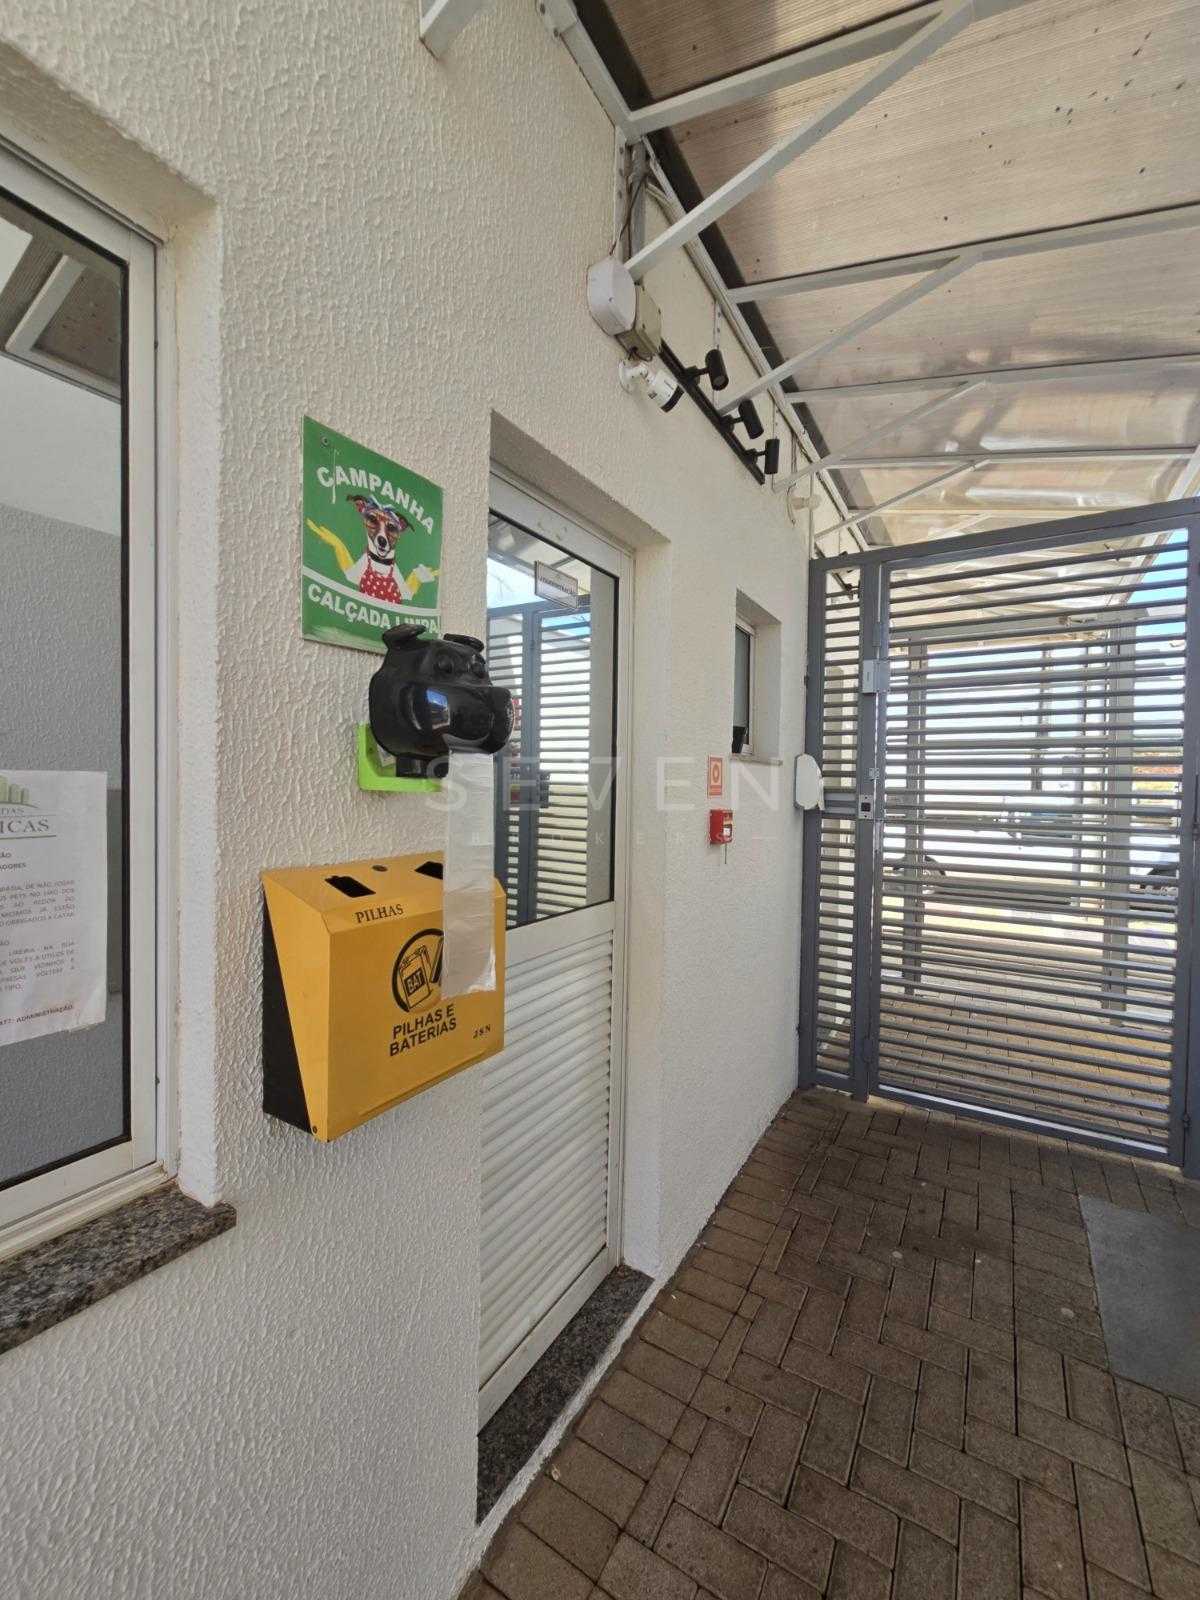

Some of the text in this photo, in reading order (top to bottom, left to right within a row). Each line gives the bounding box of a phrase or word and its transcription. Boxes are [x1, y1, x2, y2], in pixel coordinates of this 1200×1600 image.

[316, 464, 434, 536] CAMPANHA
[307, 583, 392, 629] CALÇADA
[355, 903, 405, 924] PILHAS
[406, 970, 423, 993] BAT
[389, 1018, 458, 1057] BATERIAS
[392, 1003, 456, 1040] PILHAS E
